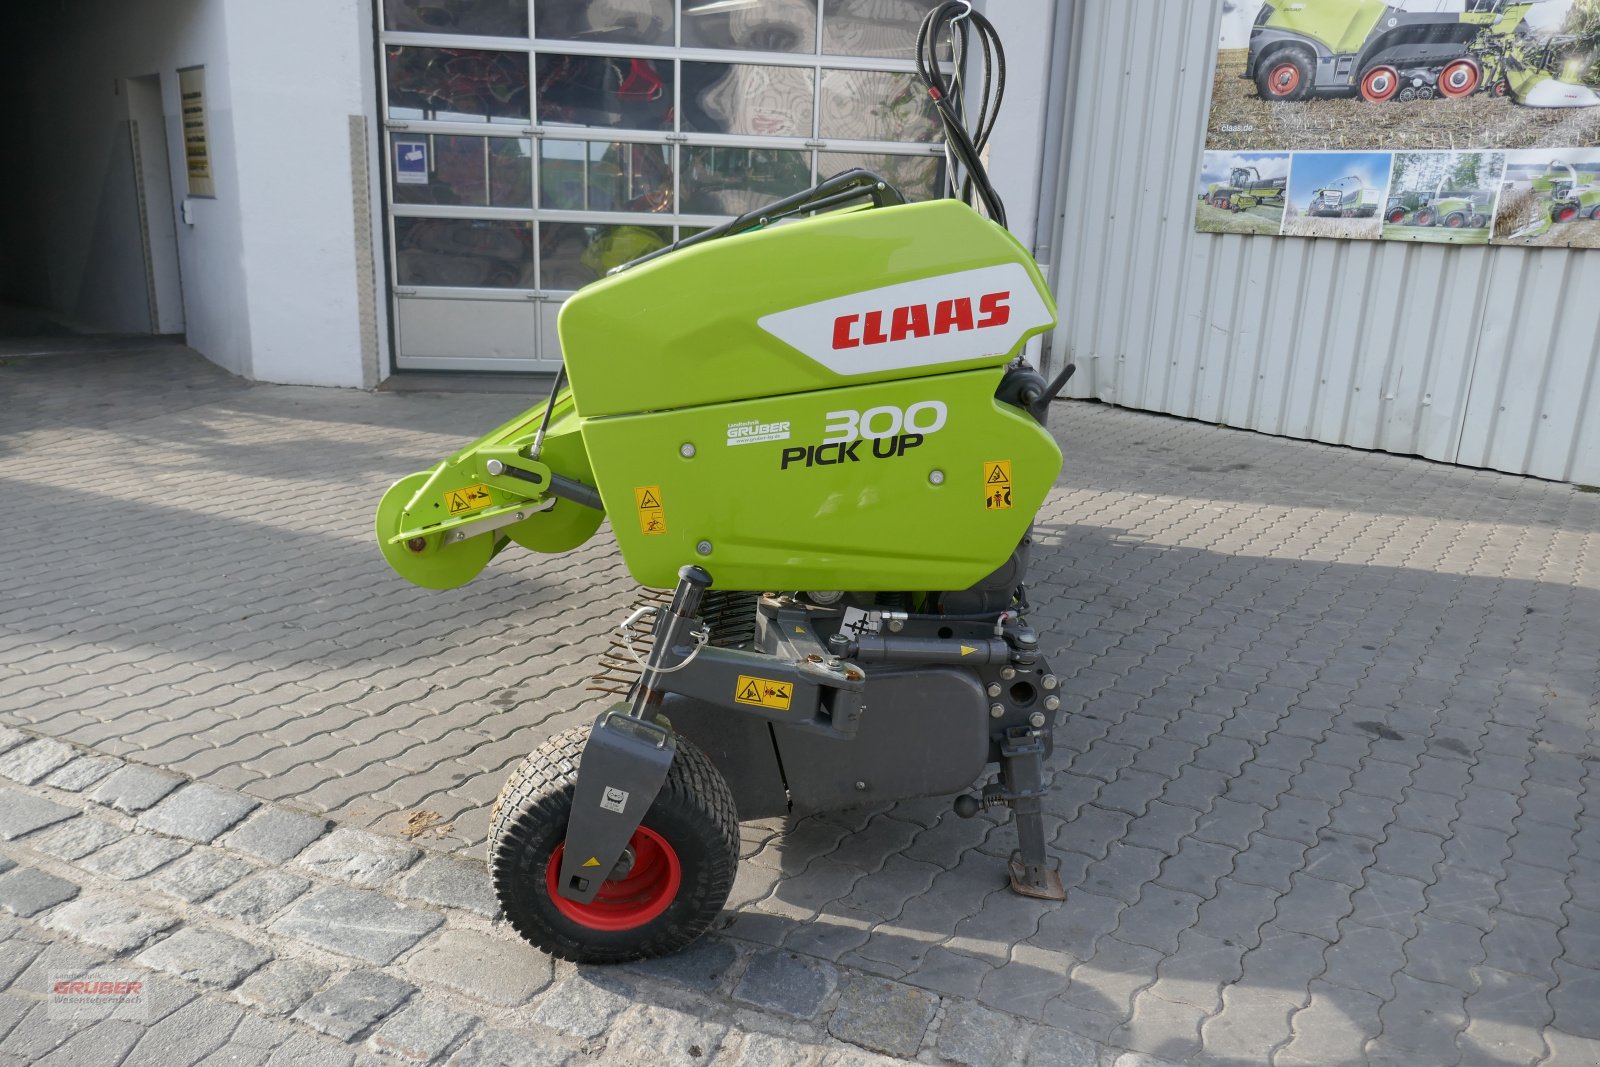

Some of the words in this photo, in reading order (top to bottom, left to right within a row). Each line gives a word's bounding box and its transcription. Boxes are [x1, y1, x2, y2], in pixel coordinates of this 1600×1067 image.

[1221, 123, 1254, 132] claas.de
[832, 291, 1011, 350] CLAAS
[727, 421, 791, 438] GRUBER
[823, 400, 948, 445] 300
[780, 439, 864, 470] PICK
[872, 433, 924, 459] UP
